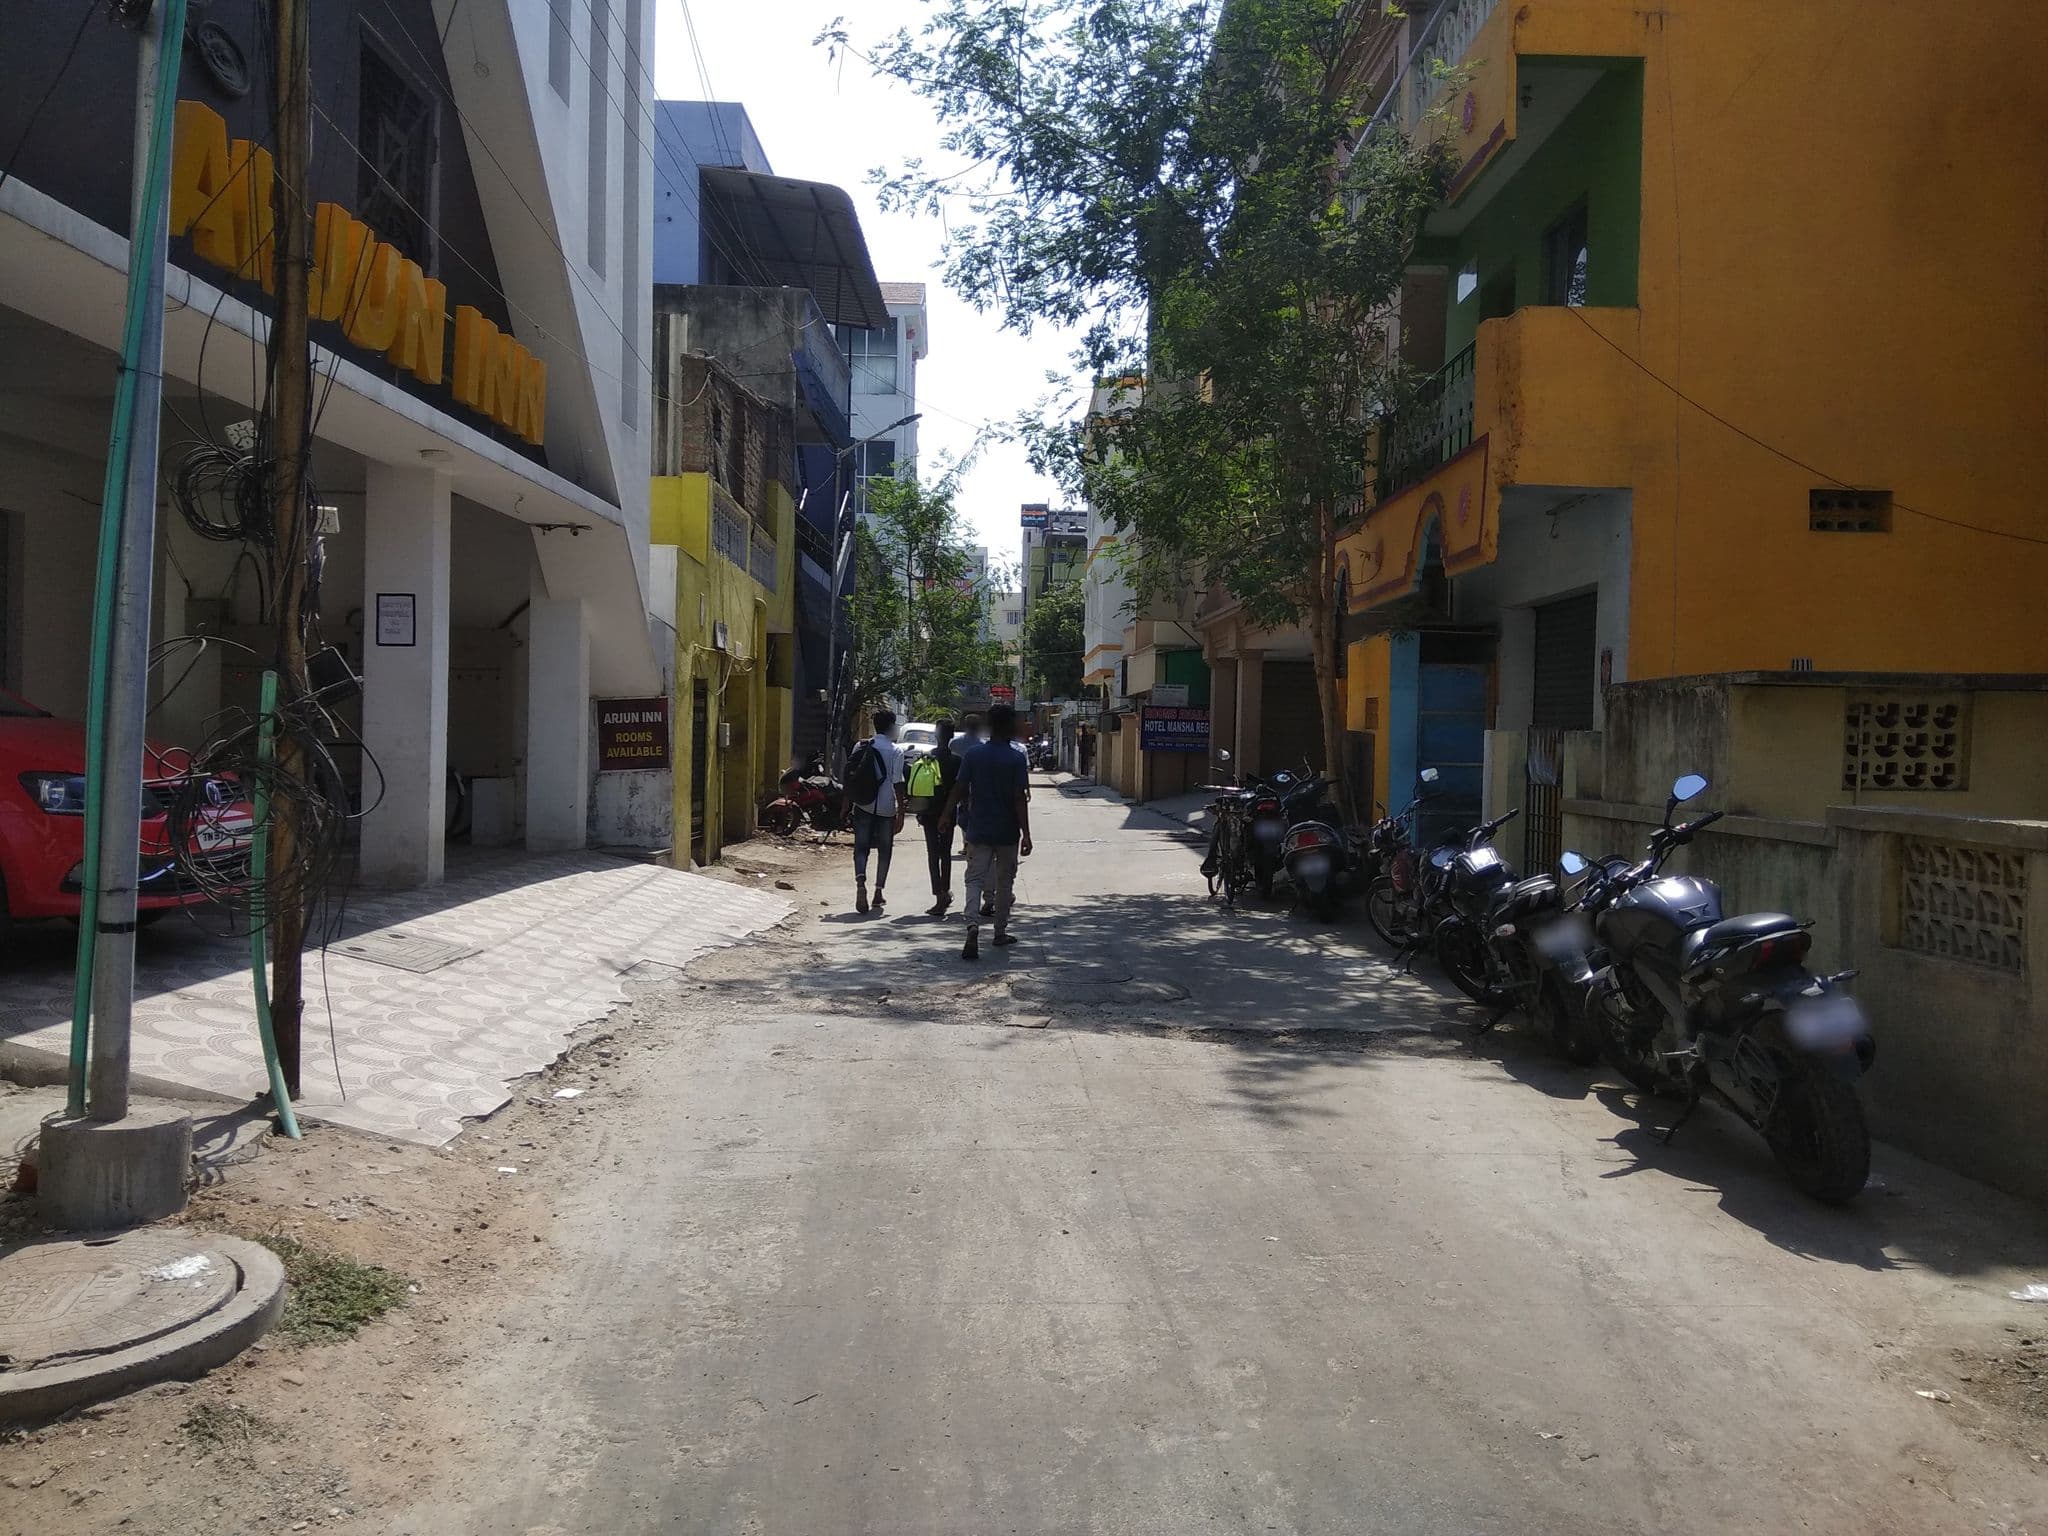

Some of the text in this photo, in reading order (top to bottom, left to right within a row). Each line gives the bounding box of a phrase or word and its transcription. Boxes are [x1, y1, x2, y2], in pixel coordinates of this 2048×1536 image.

[452, 305, 547, 446] INN
[603, 711, 662, 724] ARJUN INN
[1144, 720, 1166, 732] HOTEL
[1167, 721, 1195, 733] MANSHA
[615, 732, 652, 743] ROOMS
[607, 746, 663, 758] AVAILABLE
